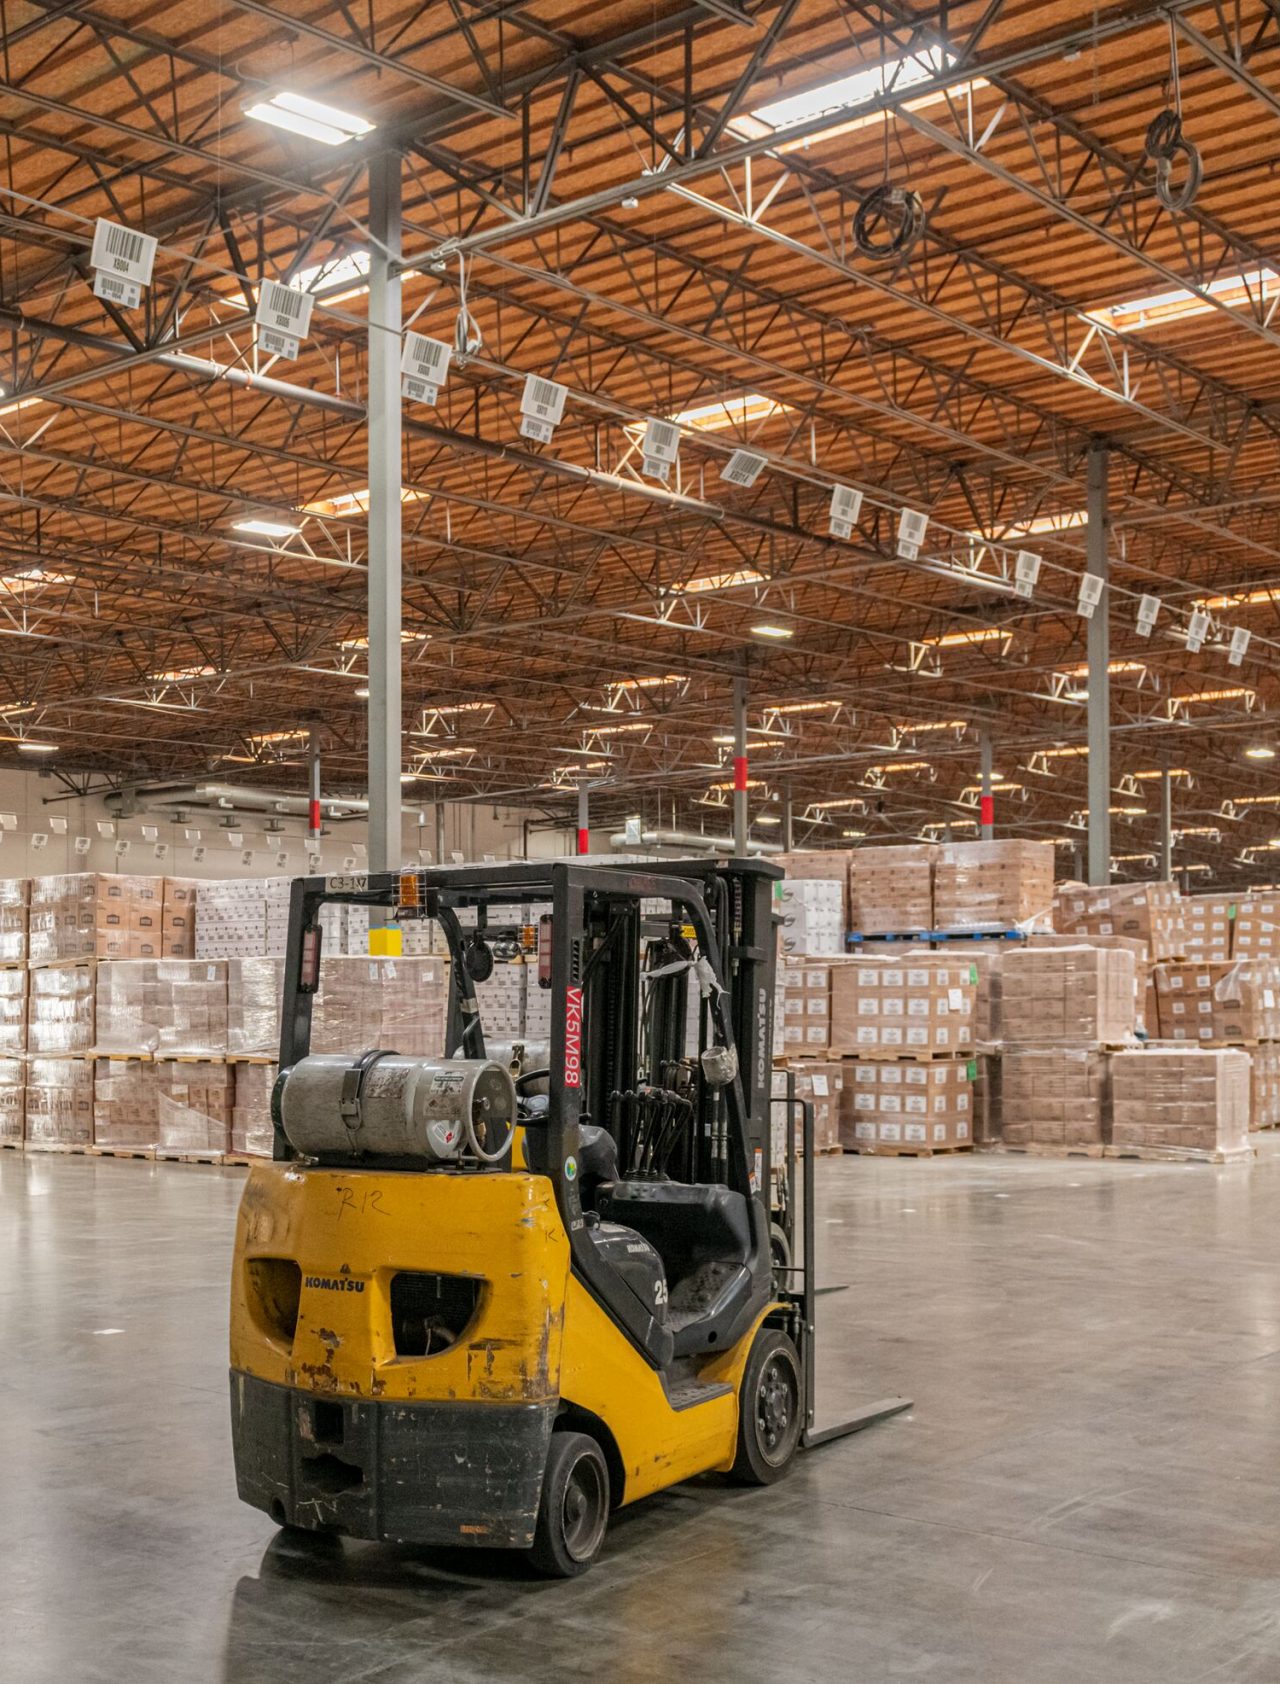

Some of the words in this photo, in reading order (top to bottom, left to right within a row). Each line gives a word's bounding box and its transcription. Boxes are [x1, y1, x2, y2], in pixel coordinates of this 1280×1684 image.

[565, 988, 580, 1084] VK5M98
[757, 988, 767, 1088] KOMATSU
[305, 1277, 365, 1292] KOMATSU
